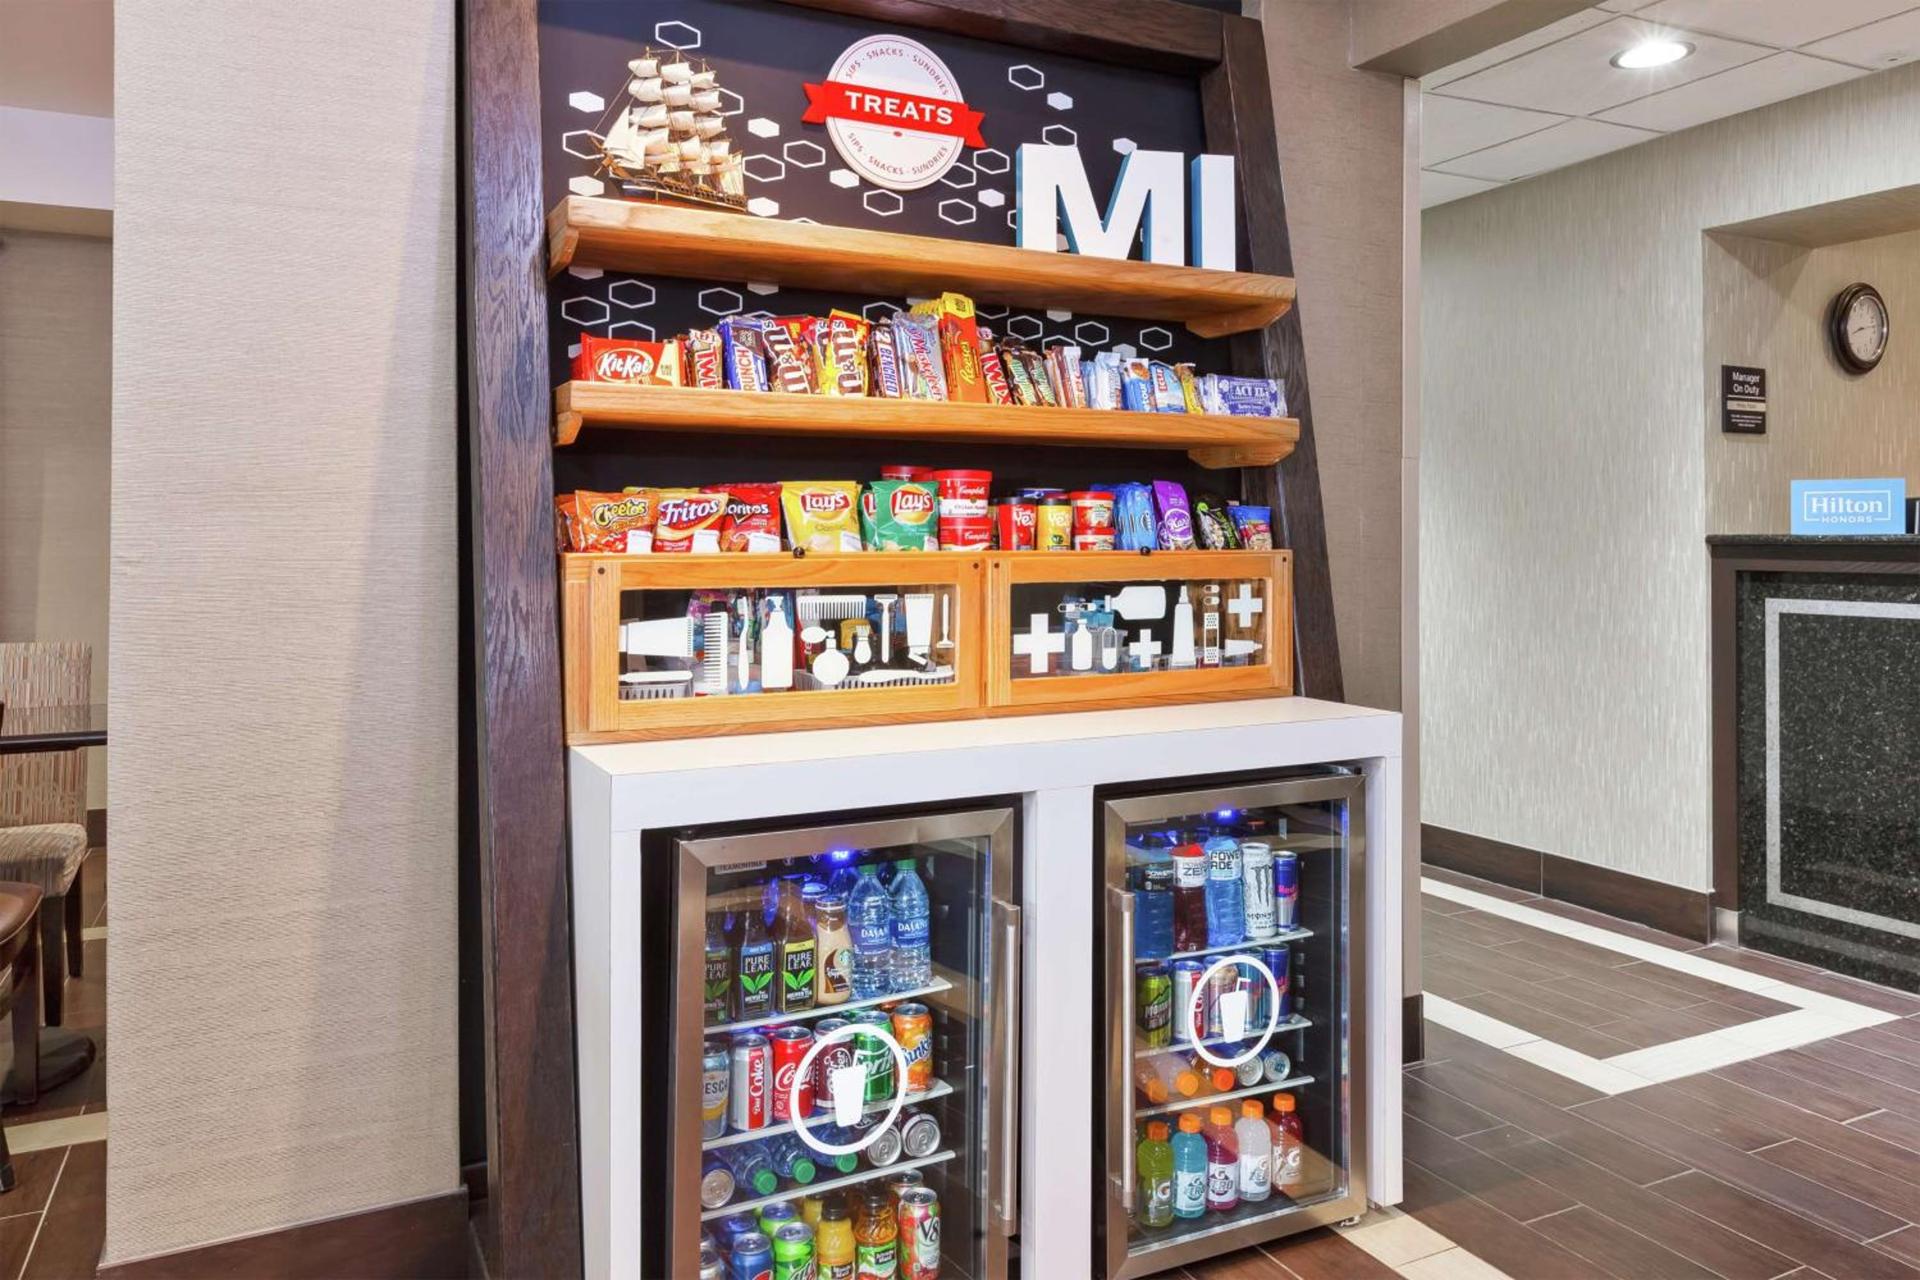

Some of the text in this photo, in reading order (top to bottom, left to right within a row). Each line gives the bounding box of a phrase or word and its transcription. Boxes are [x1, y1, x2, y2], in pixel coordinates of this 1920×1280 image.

[846, 47, 950, 96] SIPS SNACKS SUNDRIES
[844, 90, 953, 126] TREATS
[868, 154, 905, 175] SNACKS
[911, 146, 948, 175] SUNDRIES
[1016, 143, 1236, 272] MI
[696, 345, 719, 388] TWI
[735, 348, 757, 391] RUNCH
[1732, 371, 1760, 385] Manager
[1733, 383, 1760, 396] On Duty
[659, 498, 720, 526] Fritos
[726, 503, 769, 515] oritos
[1811, 496, 1883, 513] Hilton
[593, 498, 648, 527] Cheetos
[1821, 515, 1874, 524] HONORS
[1210, 849, 1240, 860] POWE
[861, 926, 887, 938] DASA
[897, 918, 925, 932] DASAN
[745, 954, 771, 967] PURE
[787, 950, 813, 962] PURE
[745, 963, 770, 974] LEAF
[787, 958, 813, 971] LEAF
[749, 1058, 764, 1097] Coke
[919, 1215, 940, 1242] V8
